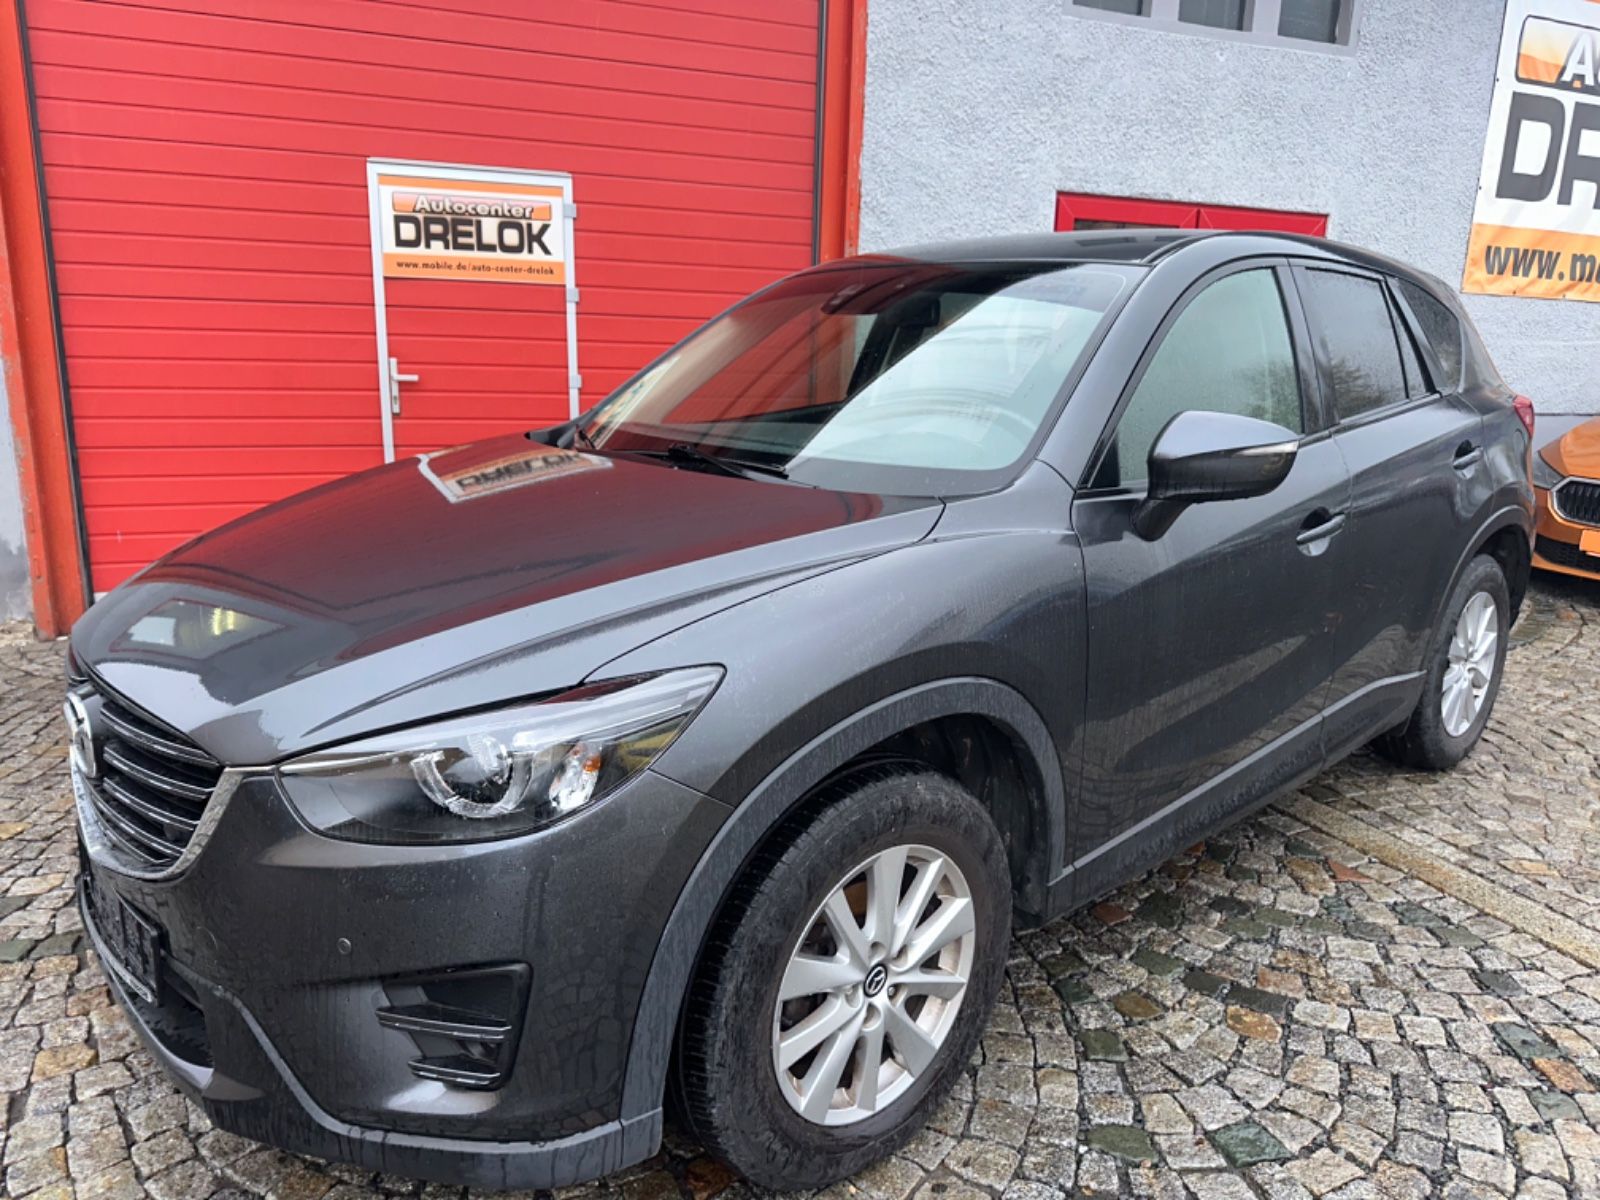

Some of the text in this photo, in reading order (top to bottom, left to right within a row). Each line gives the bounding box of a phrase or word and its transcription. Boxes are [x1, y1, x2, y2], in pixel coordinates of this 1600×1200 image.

[1560, 32, 1600, 88] A
[414, 195, 533, 219] Autocenter
[393, 214, 552, 256] DRELOK
[1485, 245, 1600, 284] www.m
